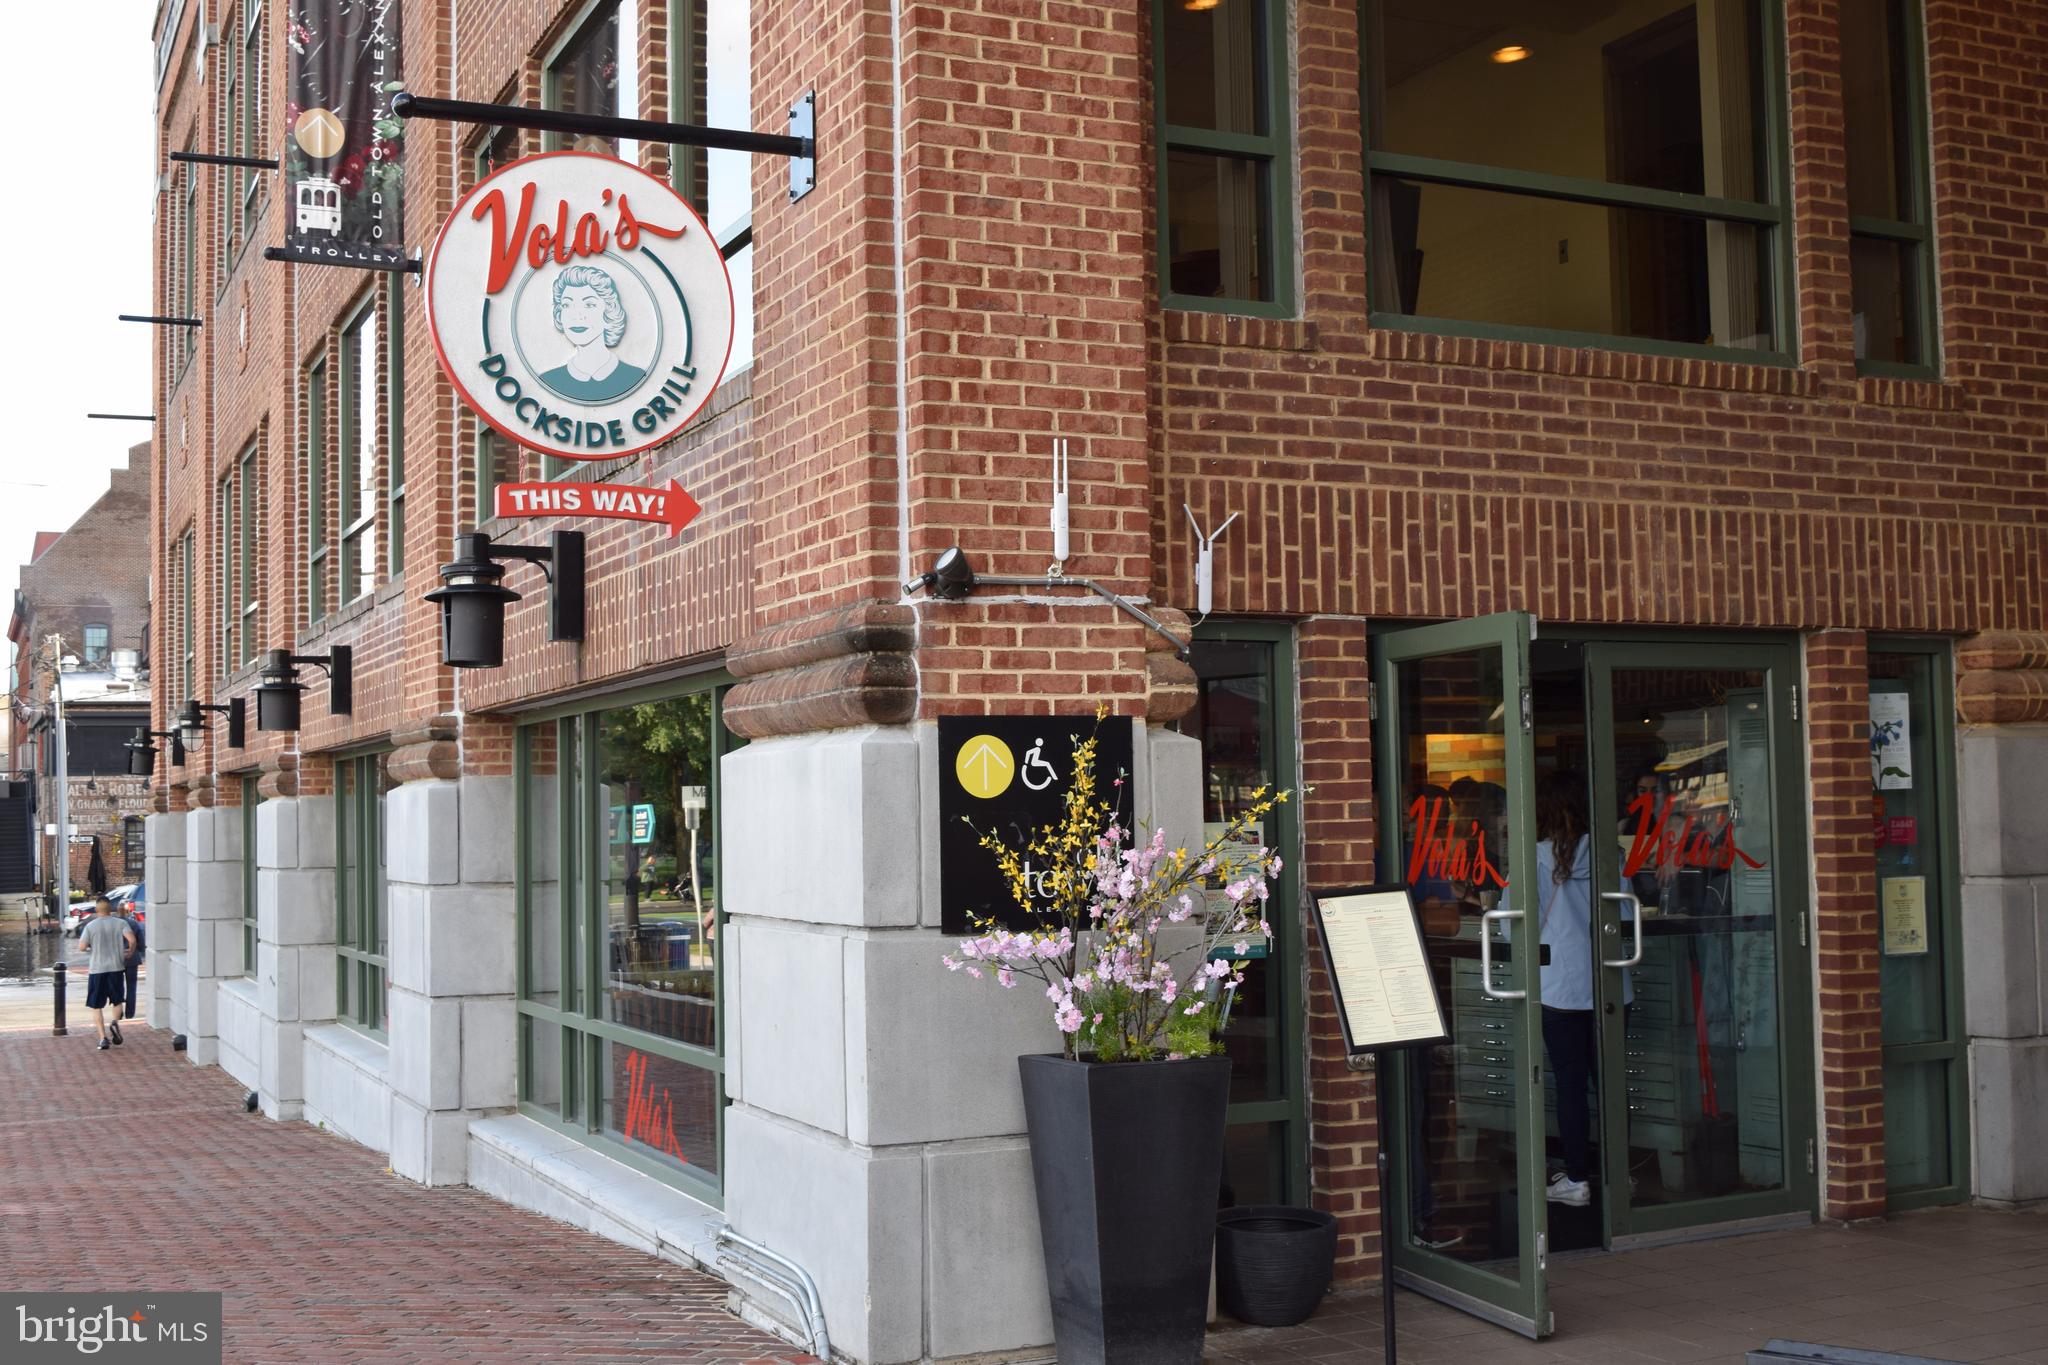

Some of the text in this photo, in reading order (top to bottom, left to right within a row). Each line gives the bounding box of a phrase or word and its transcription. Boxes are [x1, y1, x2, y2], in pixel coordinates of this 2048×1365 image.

[296, 245, 398, 263] TROLLEY
[372, 191, 383, 239] OLD
[472, 181, 687, 294] Vola's
[479, 353, 698, 448] DOCKSIDE GRILL
[509, 488, 665, 516] THIS WAY!
[68, 784, 105, 797] ALTER
[1407, 793, 1510, 888] Vola's
[1623, 791, 1768, 878] Vola's
[624, 1050, 689, 1165] Vola's
